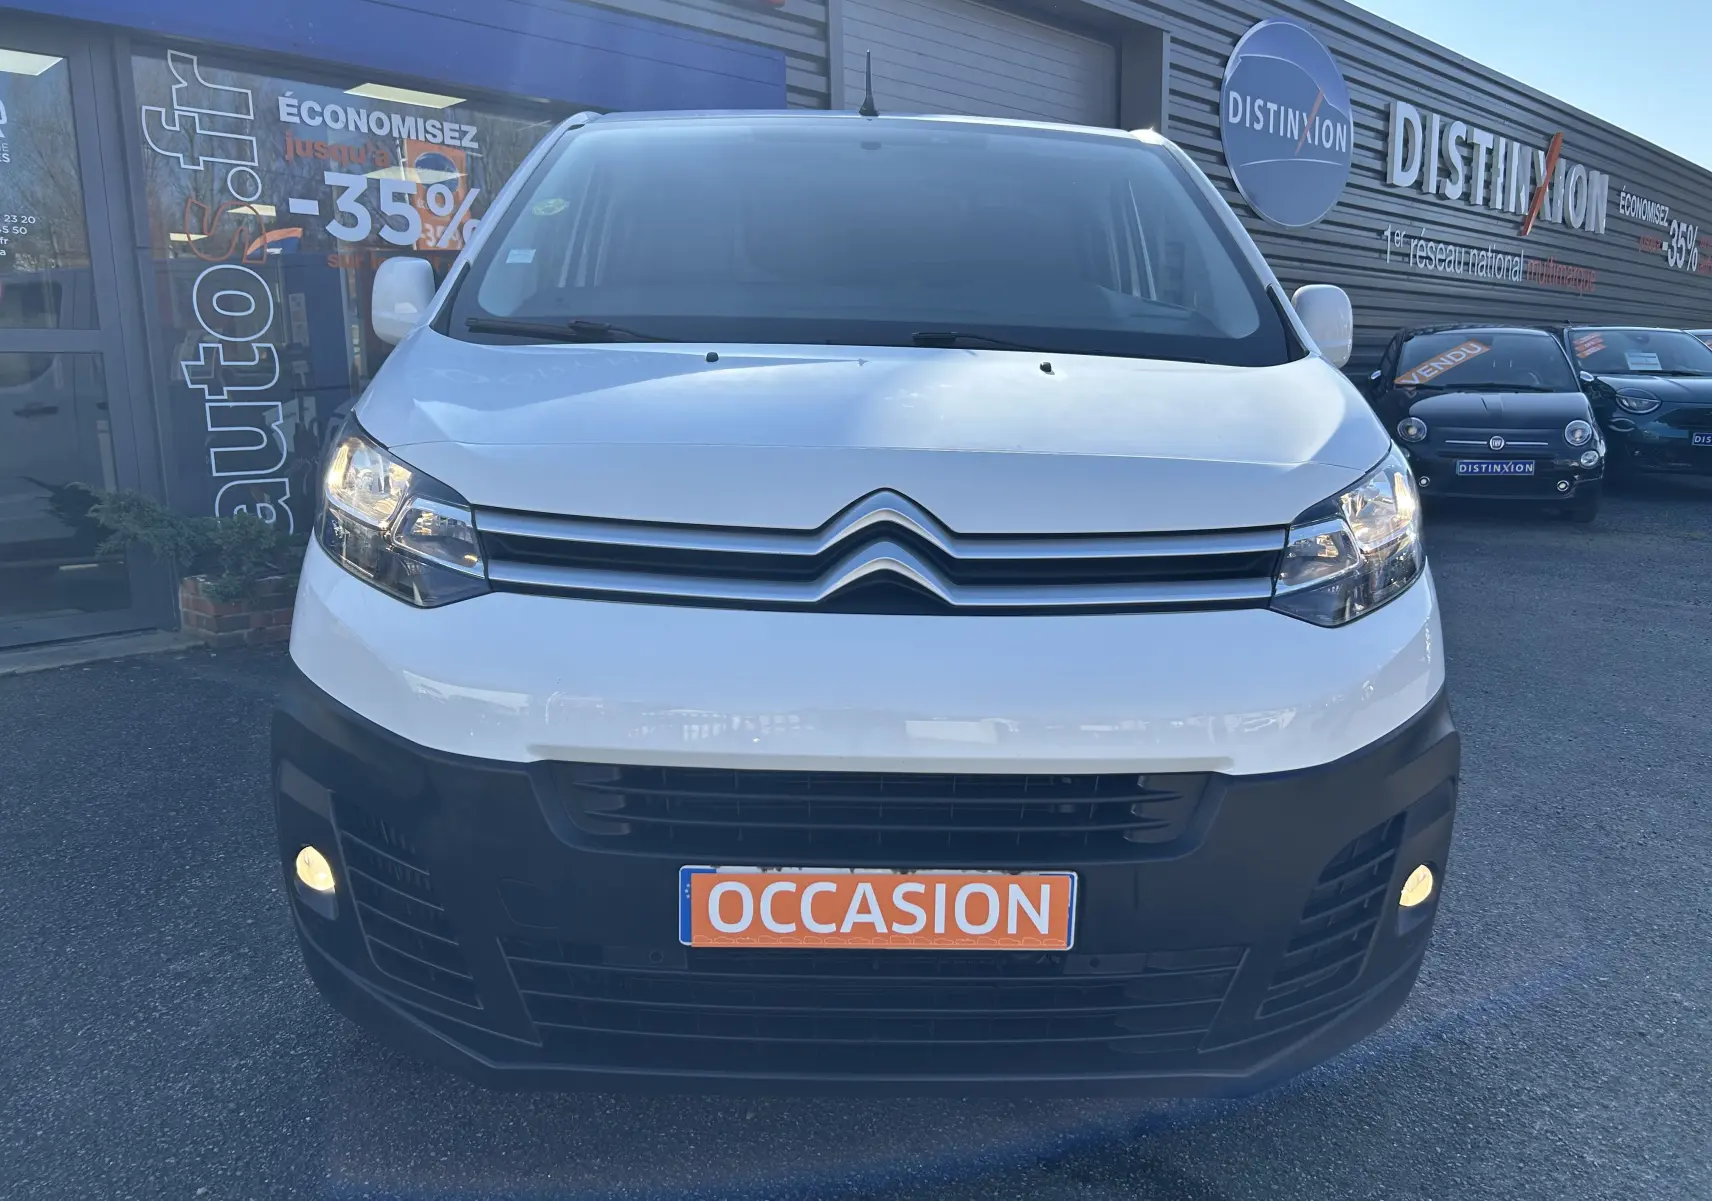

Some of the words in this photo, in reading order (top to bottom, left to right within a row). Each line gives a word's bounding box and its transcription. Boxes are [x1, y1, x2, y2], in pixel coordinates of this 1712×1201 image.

[278, 91, 479, 149] ÉCONOMISEZ
[1228, 88, 1347, 154] DISTINXION
[1387, 100, 1609, 236] DISTINXION
[4, 214, 18, 224] 23
[21, 215, 36, 224] 20
[12, 226, 28, 235] 50
[288, 170, 481, 248] -35%
[1619, 185, 1670, 227] ÉCONOMISEZ
[1384, 224, 1405, 263] 1er
[1409, 228, 1465, 274] réseau
[1468, 244, 1524, 282] national
[1662, 219, 1698, 272] -35%
[1400, 343, 1482, 385] VENDU
[1459, 461, 1533, 475] DISTINXION
[708, 881, 1051, 935] OCCASION
